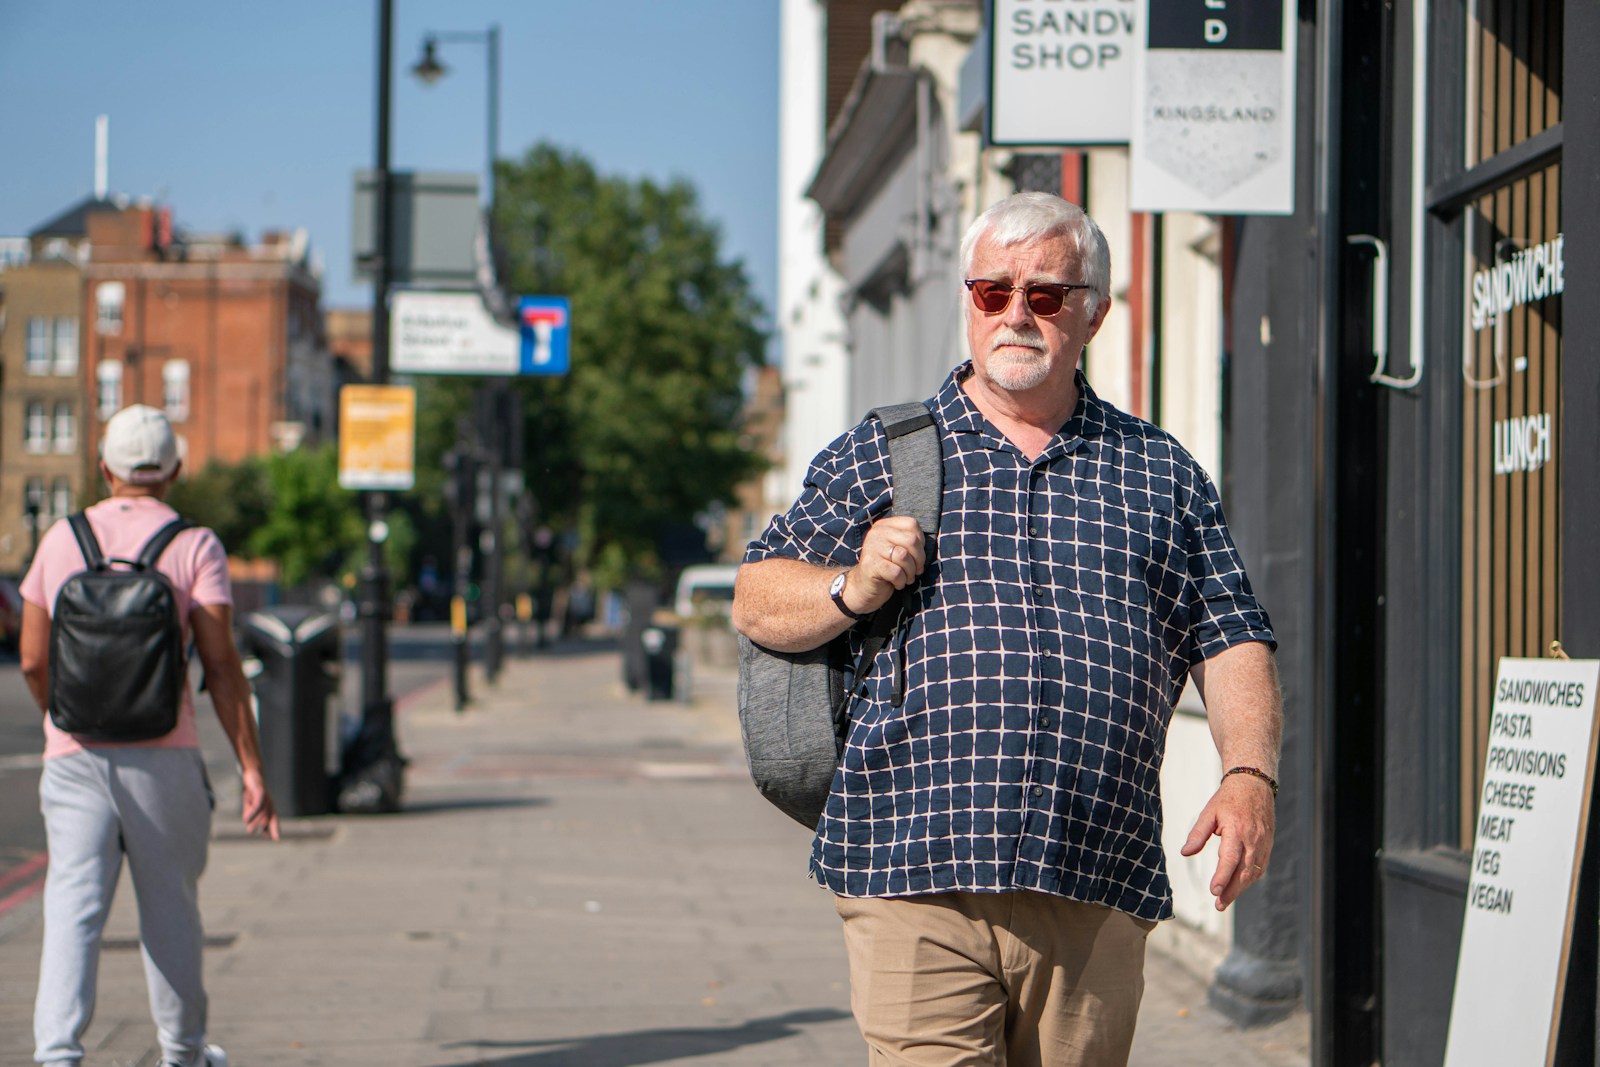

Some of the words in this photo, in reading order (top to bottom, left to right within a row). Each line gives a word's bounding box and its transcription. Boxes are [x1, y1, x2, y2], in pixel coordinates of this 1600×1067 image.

[1012, 43, 1121, 69] SHOP
[1154, 105, 1276, 121] KINGSLAND
[1495, 413, 1551, 474] LUNCH
[1498, 678, 1584, 707] SANDWICHES
[1493, 712, 1532, 738] PASTA
[1488, 747, 1566, 778] PROVISIONS
[1484, 780, 1535, 810] CHEESE
[1480, 815, 1515, 842] MEAT
[1476, 849, 1501, 875] VEG
[1471, 883, 1513, 913] VEGAN
